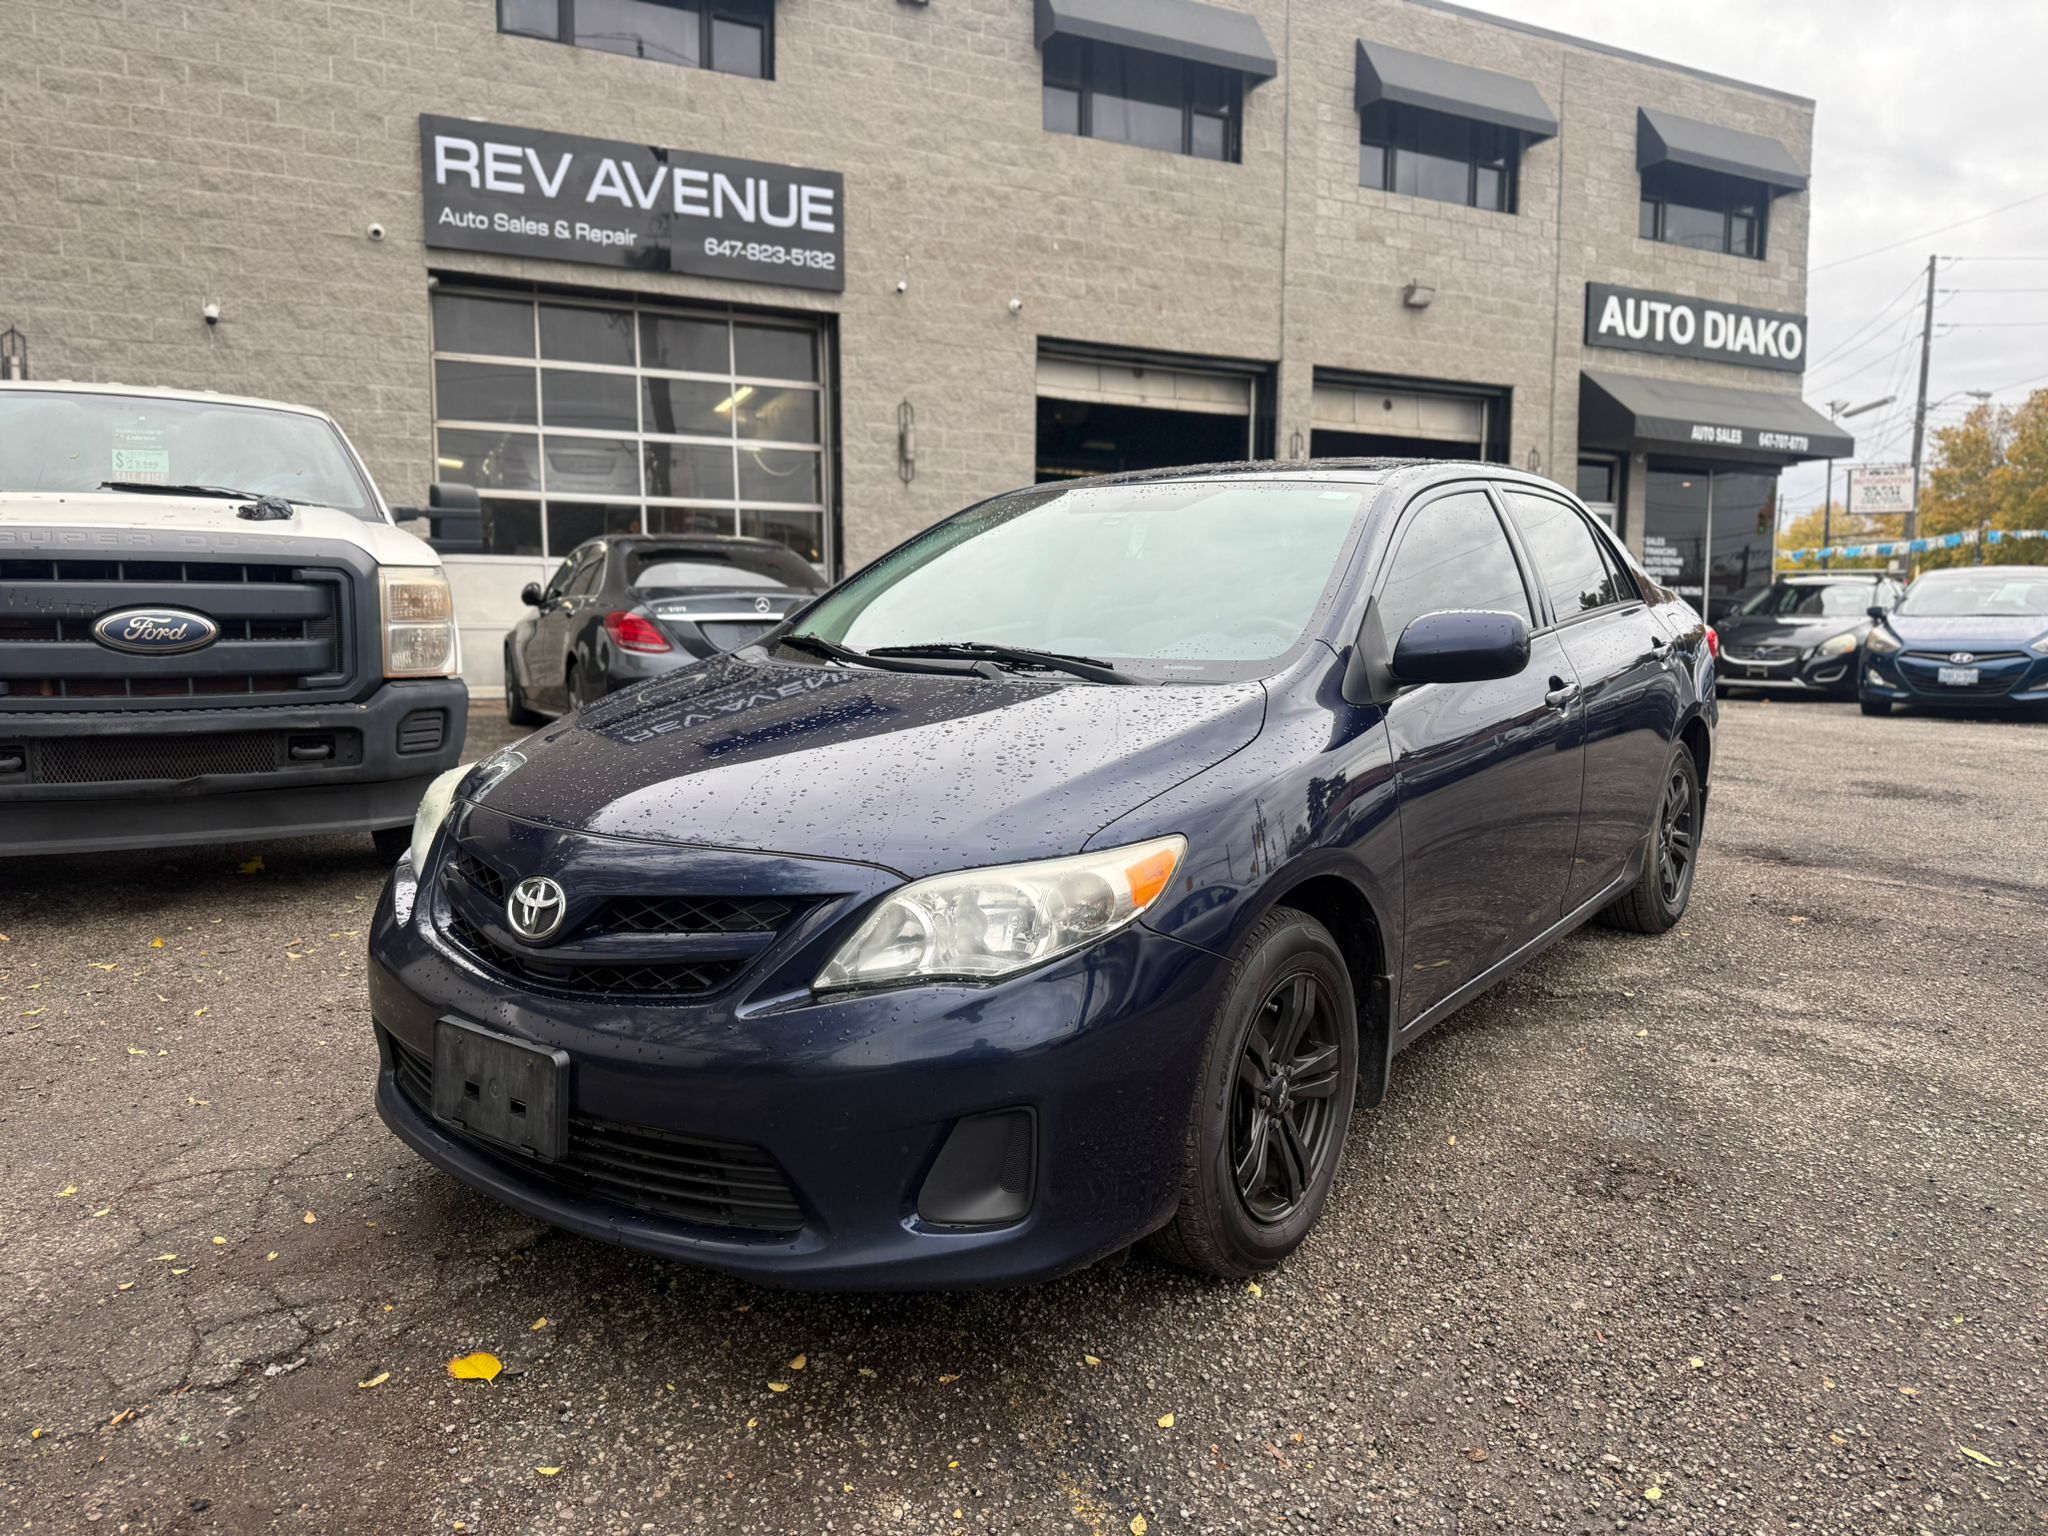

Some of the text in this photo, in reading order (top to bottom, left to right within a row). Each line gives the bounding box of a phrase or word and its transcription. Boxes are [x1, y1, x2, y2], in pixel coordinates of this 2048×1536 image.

[434, 135, 835, 233] REV AVENUE
[438, 207, 638, 247] Auto Sales & Repair
[704, 237, 836, 271] 647-823-5132
[1598, 295, 1803, 360] AUTO DIAKO
[1691, 425, 1715, 442] AUTO
[1716, 427, 1742, 445] SALES
[179, 534, 298, 551] DUTY
[124, 617, 188, 642] Ford
